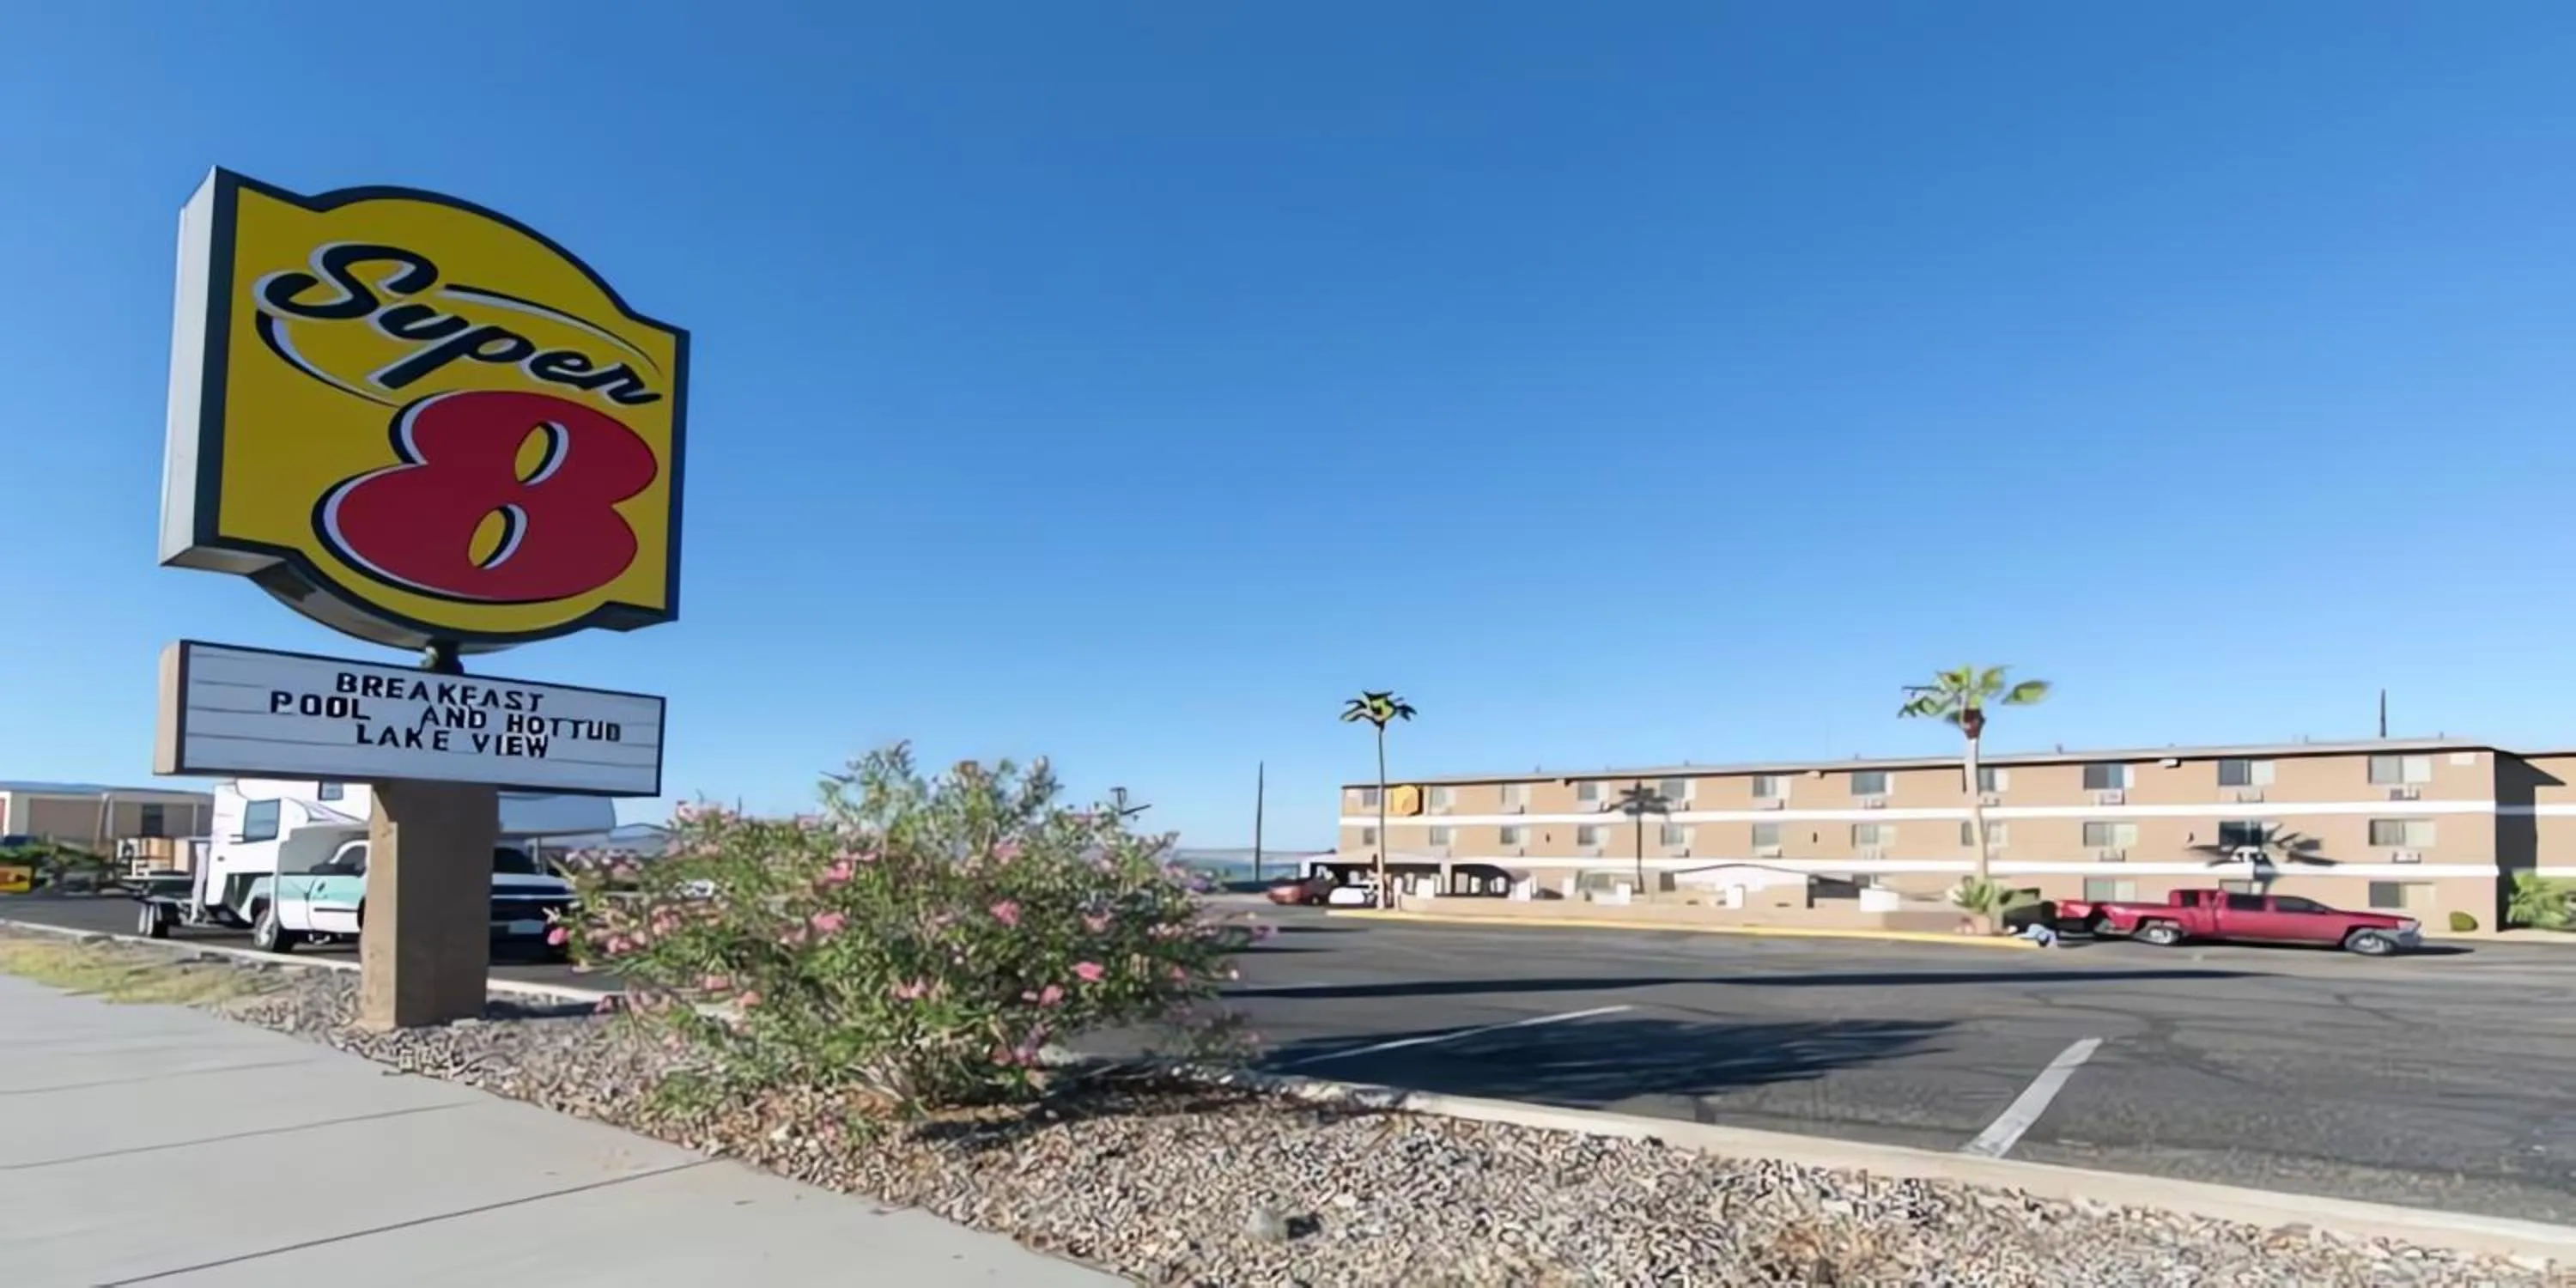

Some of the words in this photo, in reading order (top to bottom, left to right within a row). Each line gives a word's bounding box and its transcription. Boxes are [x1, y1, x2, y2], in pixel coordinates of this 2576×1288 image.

[252, 240, 664, 406] Super
[310, 390, 659, 605] 8
[270, 690, 372, 721] POOL
[421, 704, 487, 730] AND
[336, 671, 544, 713] BREAKFAST
[355, 721, 451, 752] LAKE
[471, 732, 550, 758] VIEW
